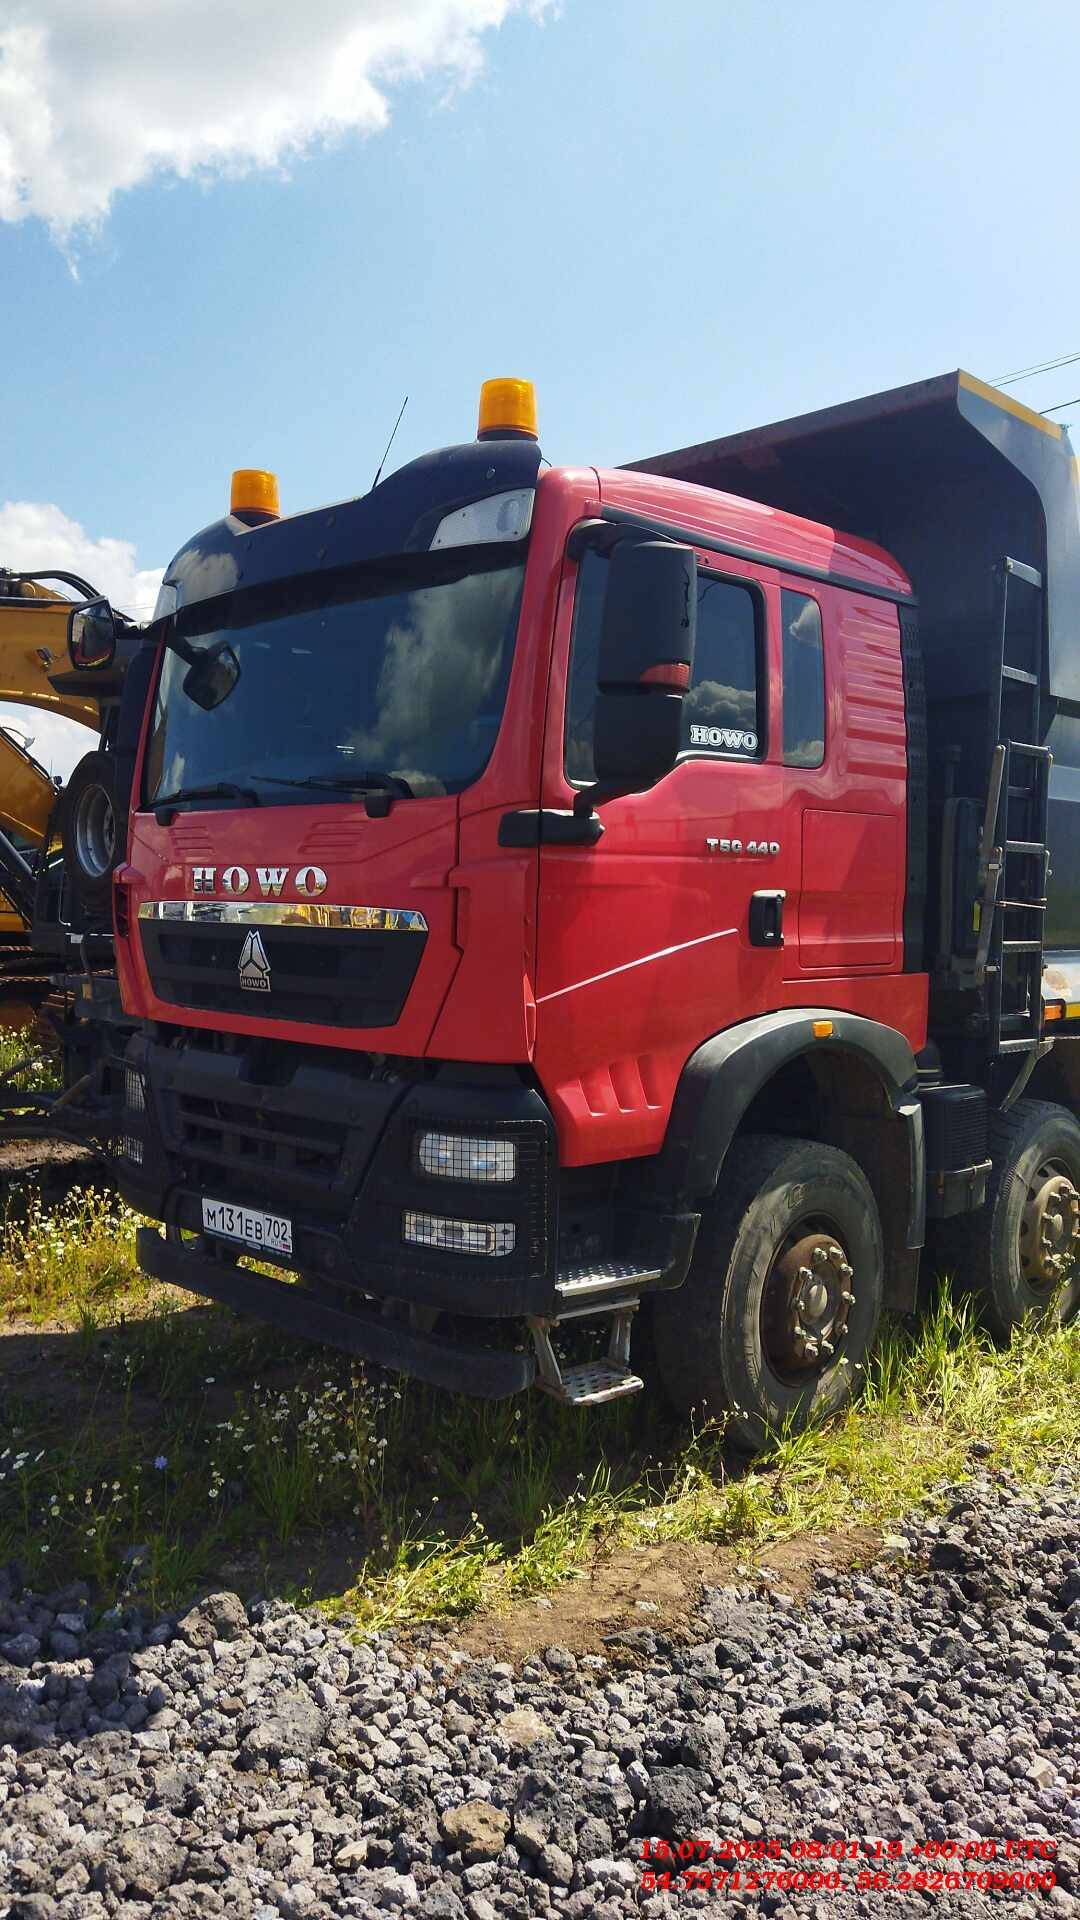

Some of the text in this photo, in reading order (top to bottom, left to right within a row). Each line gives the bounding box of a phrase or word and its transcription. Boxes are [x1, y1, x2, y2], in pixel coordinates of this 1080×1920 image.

[690, 725, 758, 750] HOWO
[746, 841, 780, 855] 440
[192, 866, 328, 897] HOWO
[241, 978, 267, 988] HOWO
